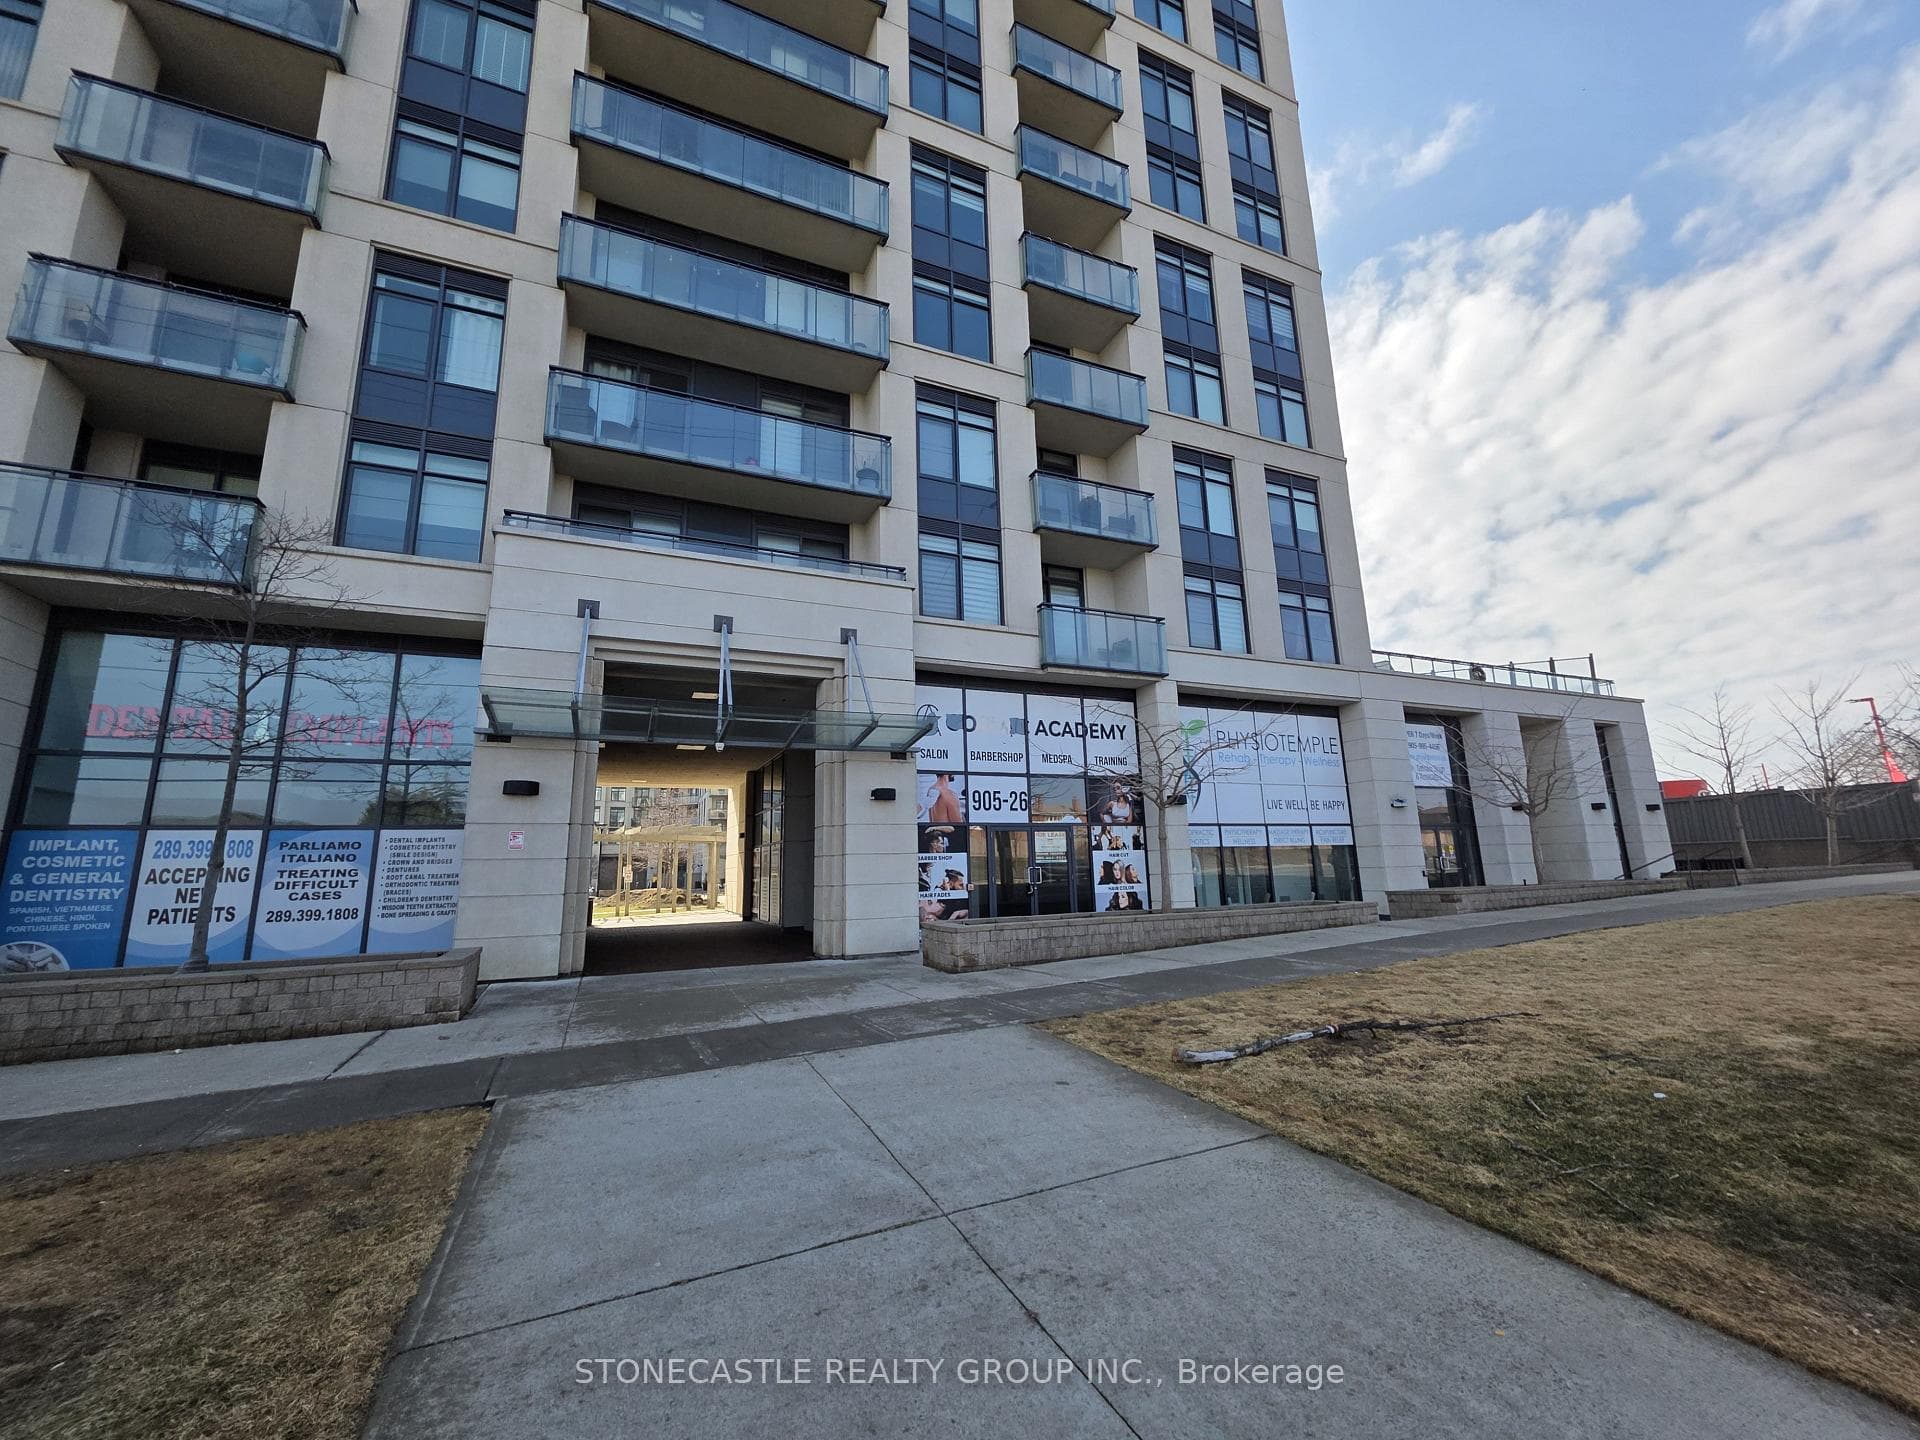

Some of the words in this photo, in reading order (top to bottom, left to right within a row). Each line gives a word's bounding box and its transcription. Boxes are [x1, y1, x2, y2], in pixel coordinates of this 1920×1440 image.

[1034, 720, 1127, 740] ACADEMY
[1216, 730, 1339, 754] PHYSIOTEMPLE
[920, 749, 949, 759] SALON
[970, 751, 1024, 762] BARBERSHOP
[1041, 754, 1073, 764] MEDSPA
[1094, 756, 1128, 766] TRAINING
[1219, 752, 1250, 763] Rehab
[1260, 754, 1297, 767] Therapy
[1303, 756, 1340, 767] Wellness
[972, 790, 1028, 811] 905-26
[1266, 800, 1283, 809] LIVE
[1310, 800, 1320, 810] BE
[1323, 800, 1345, 810] HAPPY
[28, 839, 119, 853] IMPLANT,
[279, 841, 362, 851] PARLIAMO
[22, 856, 126, 868] COSMETIC
[281, 853, 357, 863] ITALIANO
[9, 873, 24, 885] &
[31, 872, 125, 885] GENERAL
[144, 867, 251, 885] ACCEPING
[277, 868, 359, 878] TREATING
[274, 880, 359, 890] DIFFICULT
[10, 887, 125, 902] DENTISTRY
[175, 888, 204, 904] NE
[288, 891, 342, 901] CASES
[9, 906, 51, 914] SPANISH,
[55, 905, 114, 913] VIETNAMESE,
[147, 906, 236, 925] PATIETS
[265, 908, 359, 923] 289.399.1808
[6, 924, 70, 932] PORTUGUESE
[73, 922, 111, 930] SPOKEN
